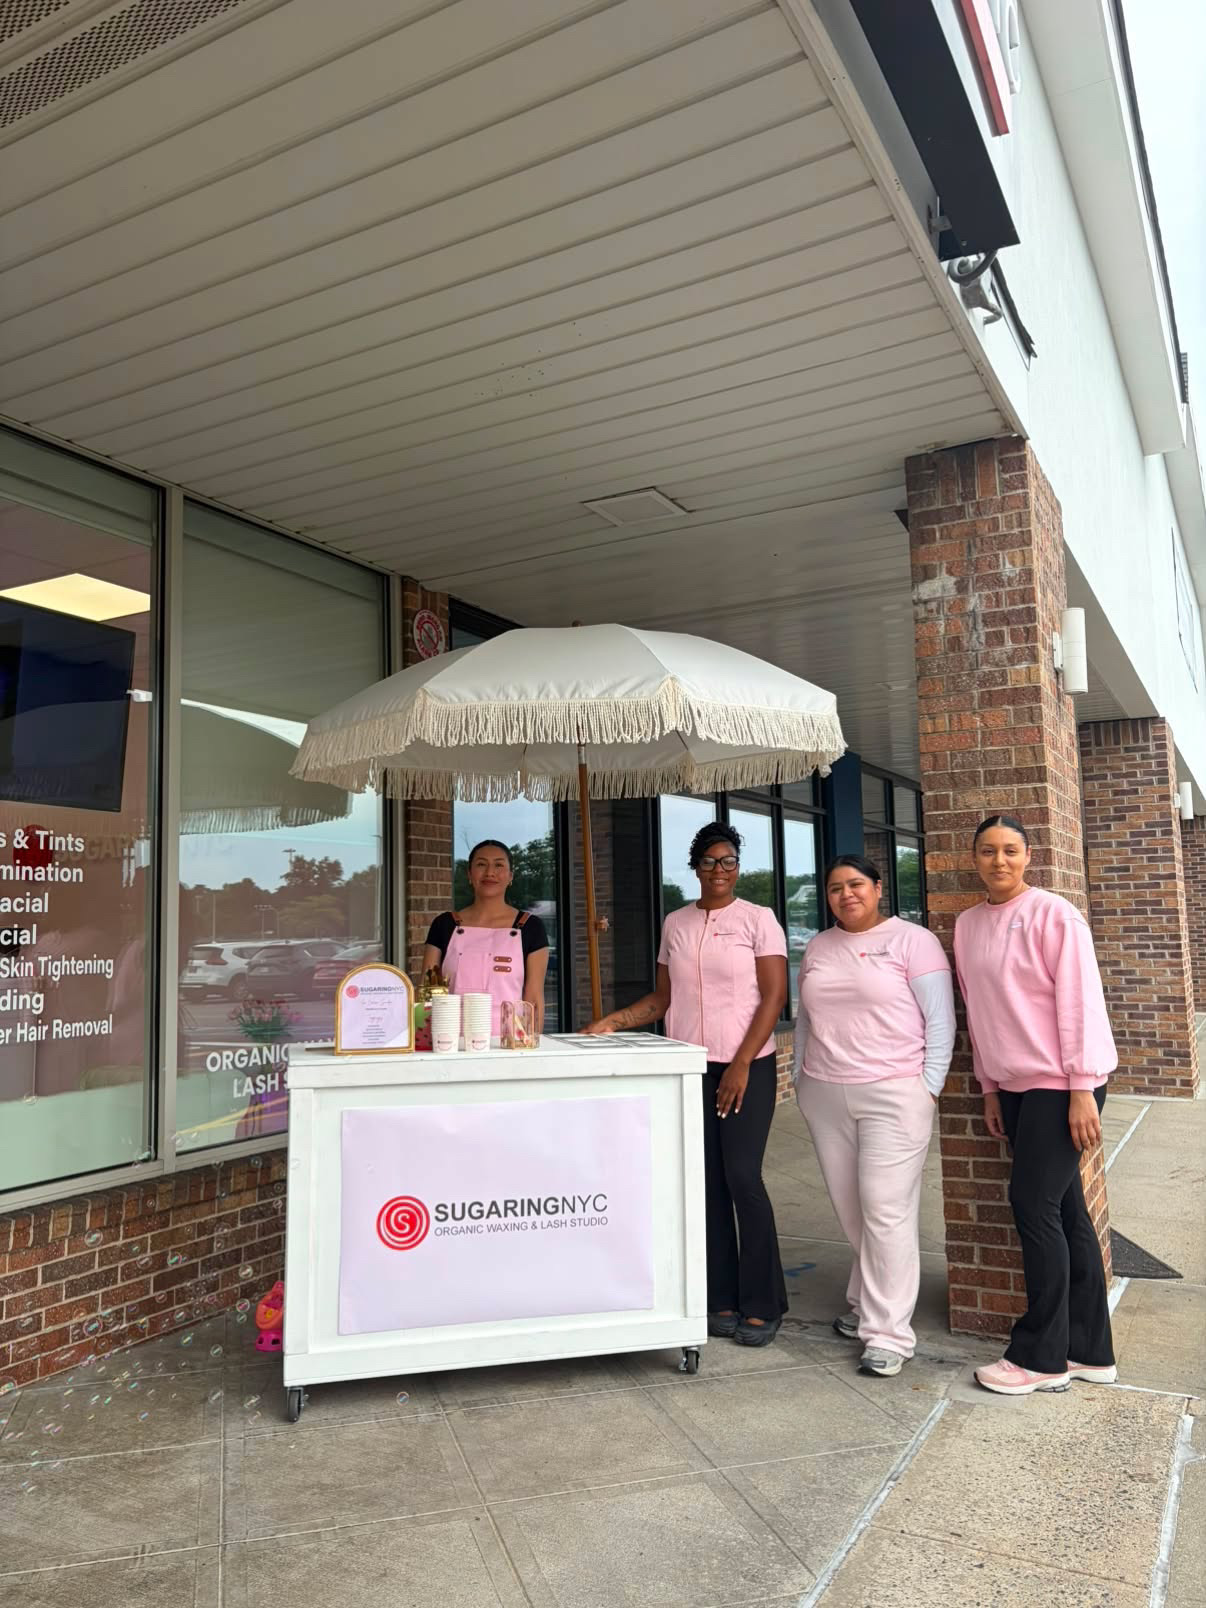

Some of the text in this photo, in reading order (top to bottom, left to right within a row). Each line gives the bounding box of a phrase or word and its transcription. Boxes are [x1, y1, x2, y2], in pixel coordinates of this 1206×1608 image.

[13, 829, 29, 849] &
[35, 829, 85, 852] Tints
[0, 892, 49, 913] acial
[0, 923, 37, 945] cial
[0, 953, 114, 981] Skin Tightening
[0, 989, 44, 1015] ding
[16, 1020, 48, 1043] Hair
[52, 1014, 113, 1040] Removal
[233, 1072, 279, 1098] LASH
[434, 1193, 608, 1222] SUGARINGNYC
[434, 1216, 609, 1237] ORGANIC WAXING & LASH STUDIO
